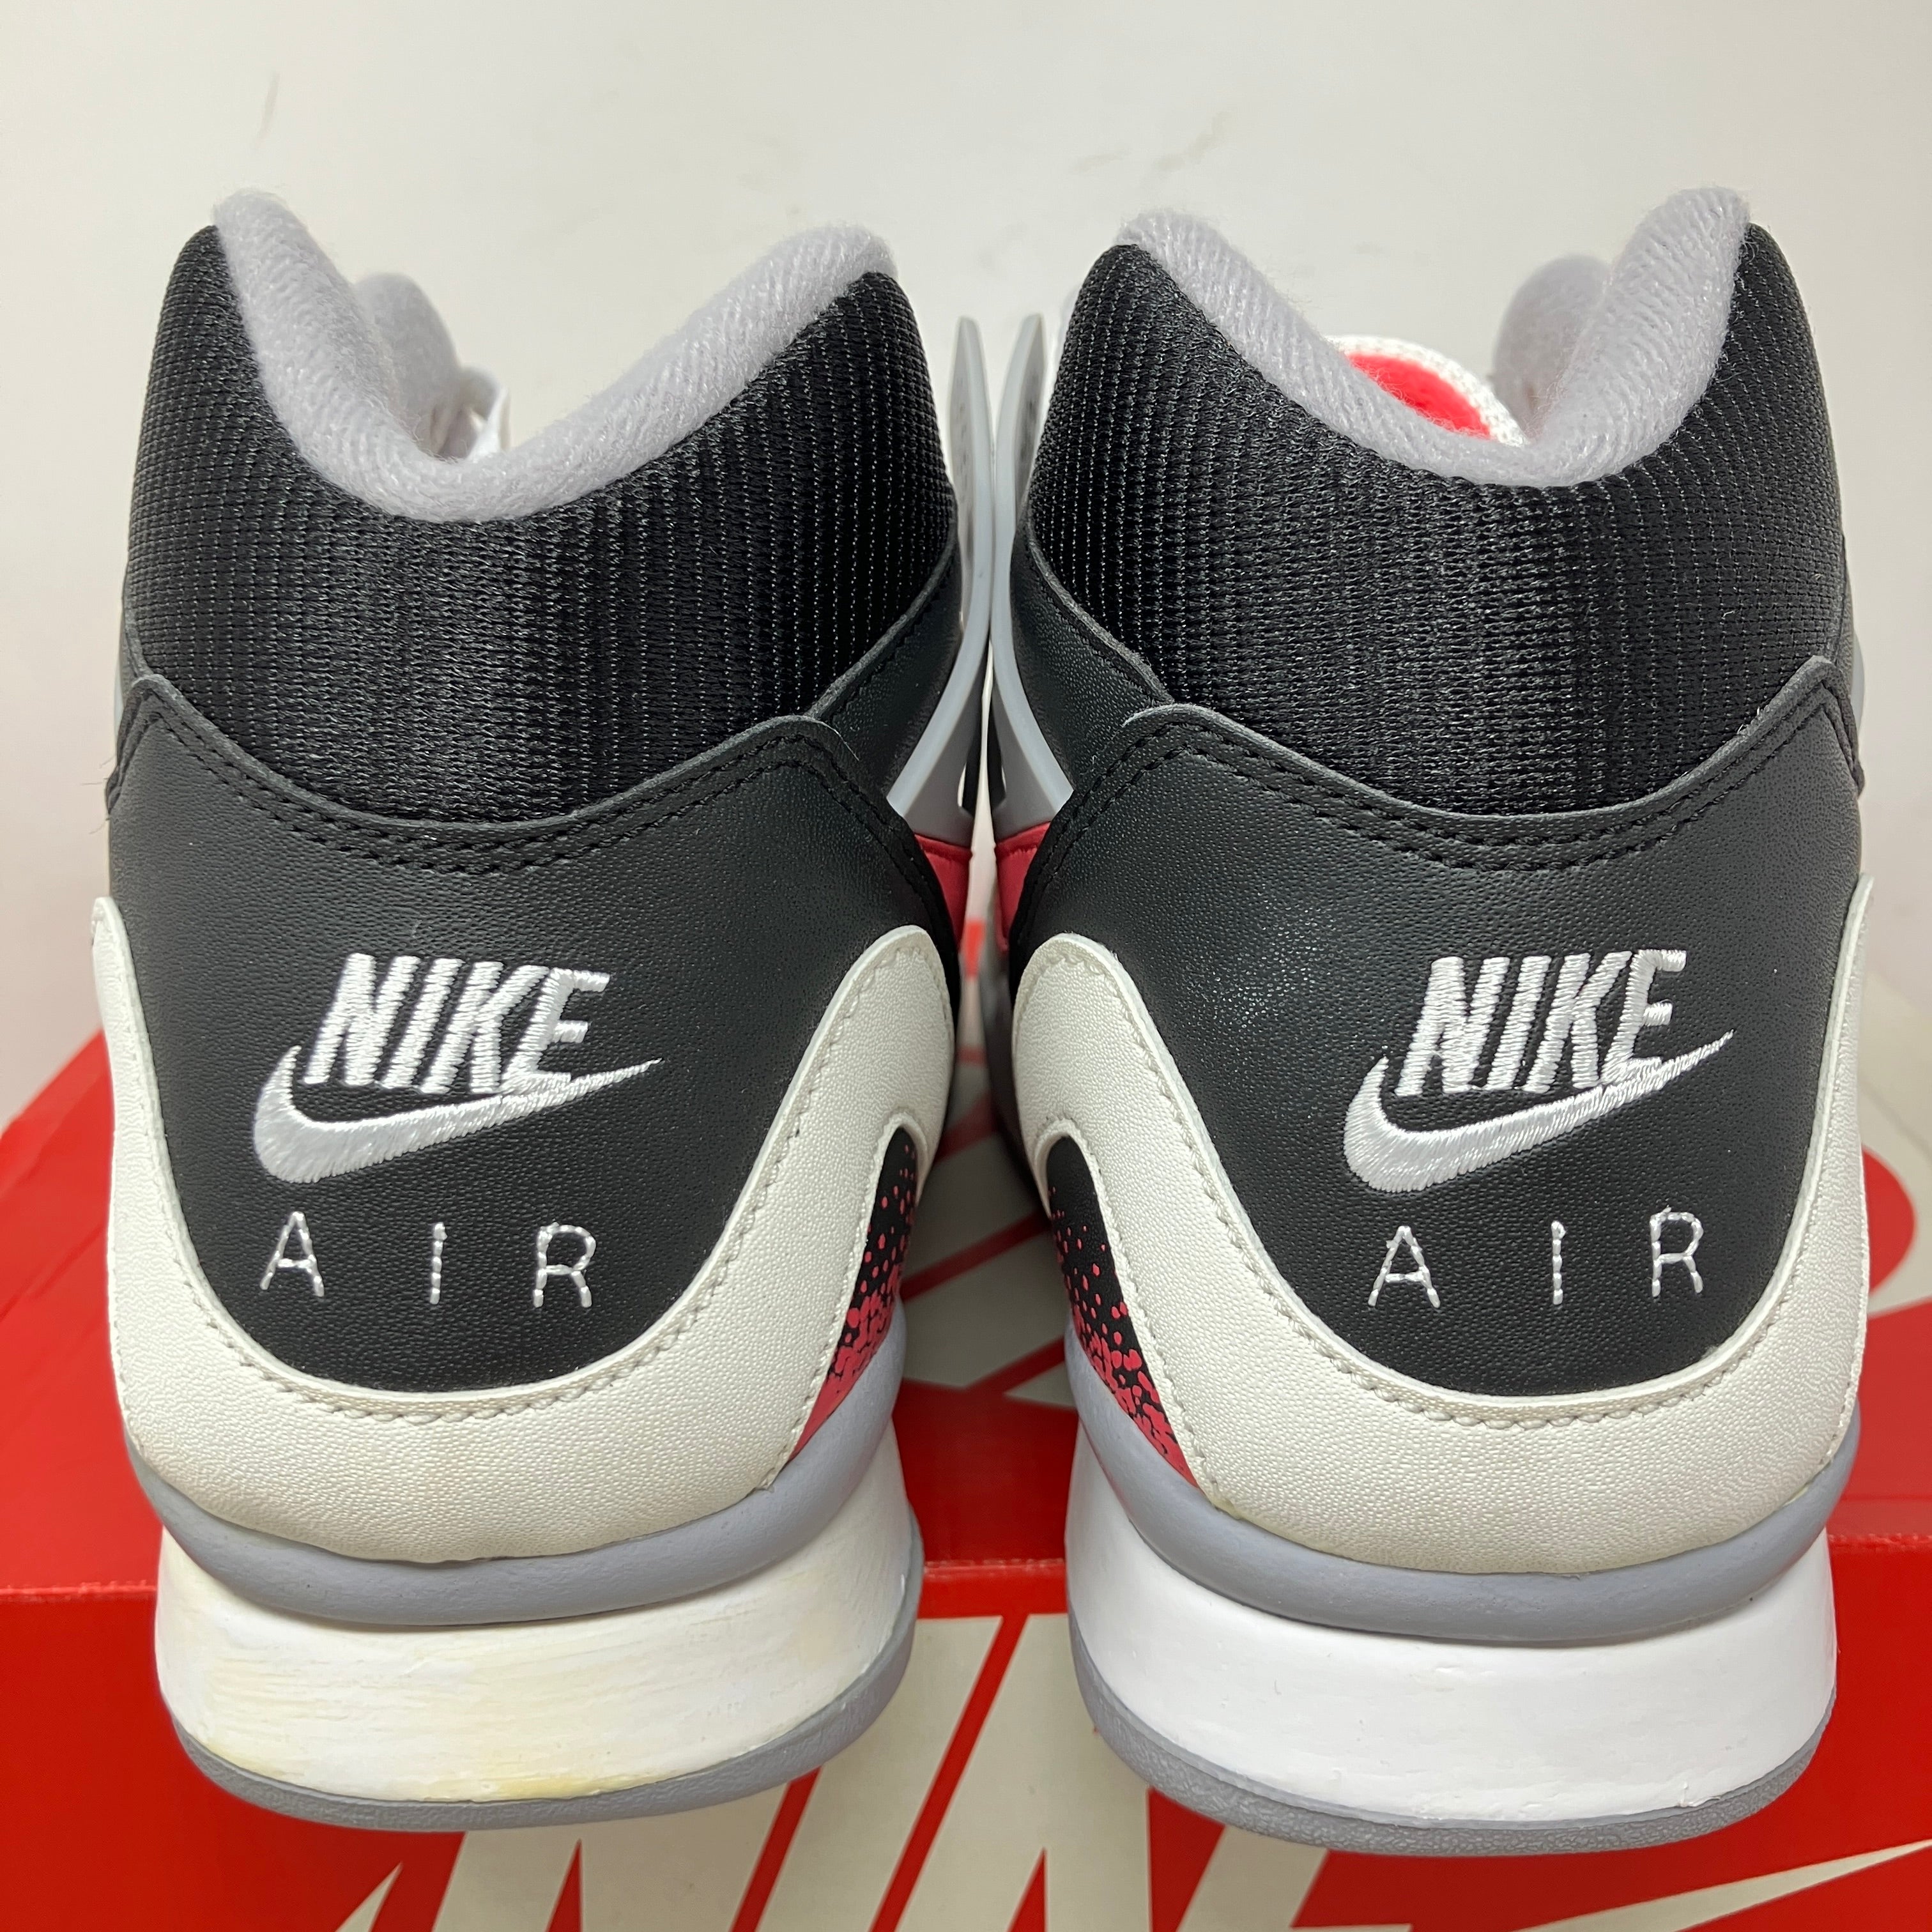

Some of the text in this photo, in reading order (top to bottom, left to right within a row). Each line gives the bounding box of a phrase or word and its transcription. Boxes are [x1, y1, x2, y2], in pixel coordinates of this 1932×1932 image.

[303, 952, 610, 1094] NIKE
[1394, 949, 1686, 1098] NIKE
[259, 1210, 597, 1308] AIR
[1367, 1204, 1704, 1308] AIR
